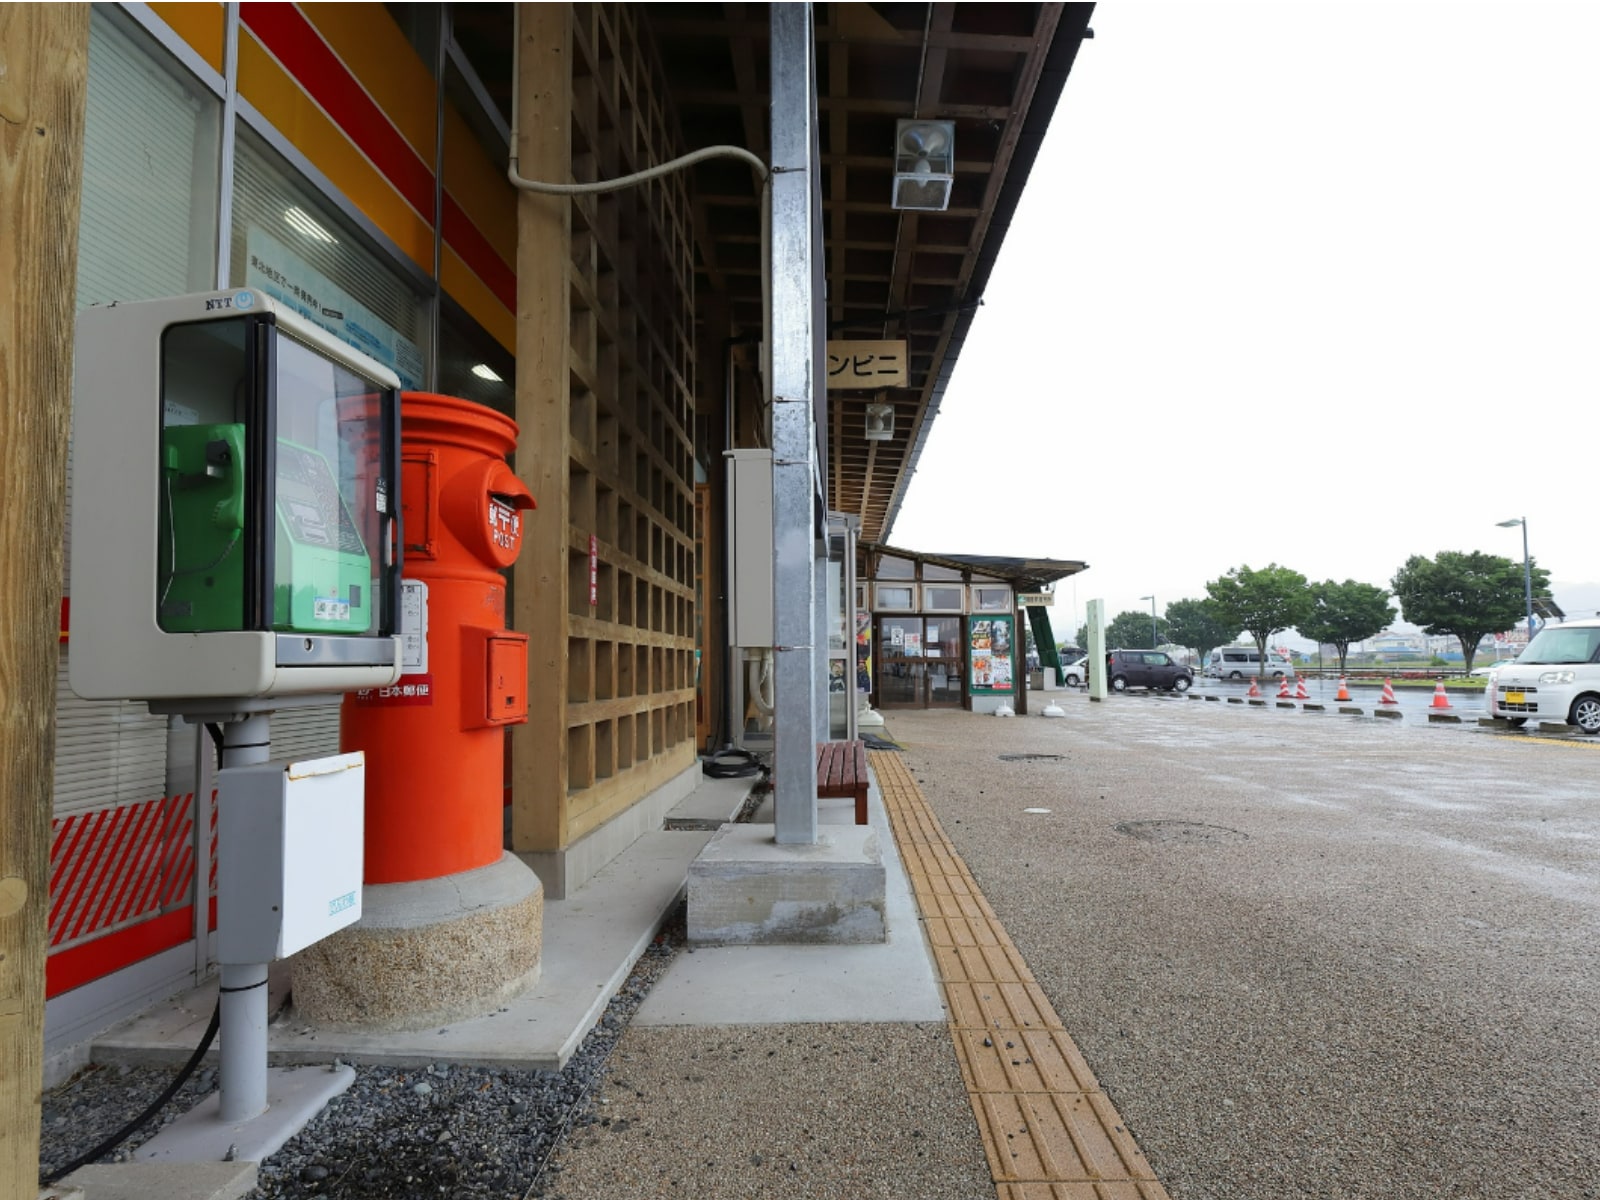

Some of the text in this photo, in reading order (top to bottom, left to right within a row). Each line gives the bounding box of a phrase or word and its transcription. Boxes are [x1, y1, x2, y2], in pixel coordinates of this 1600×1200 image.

[206, 297, 232, 311] NTT
[829, 355, 898, 376] ンビニ
[493, 529, 515, 550] POST
[380, 684, 429, 697] 日本郵便
